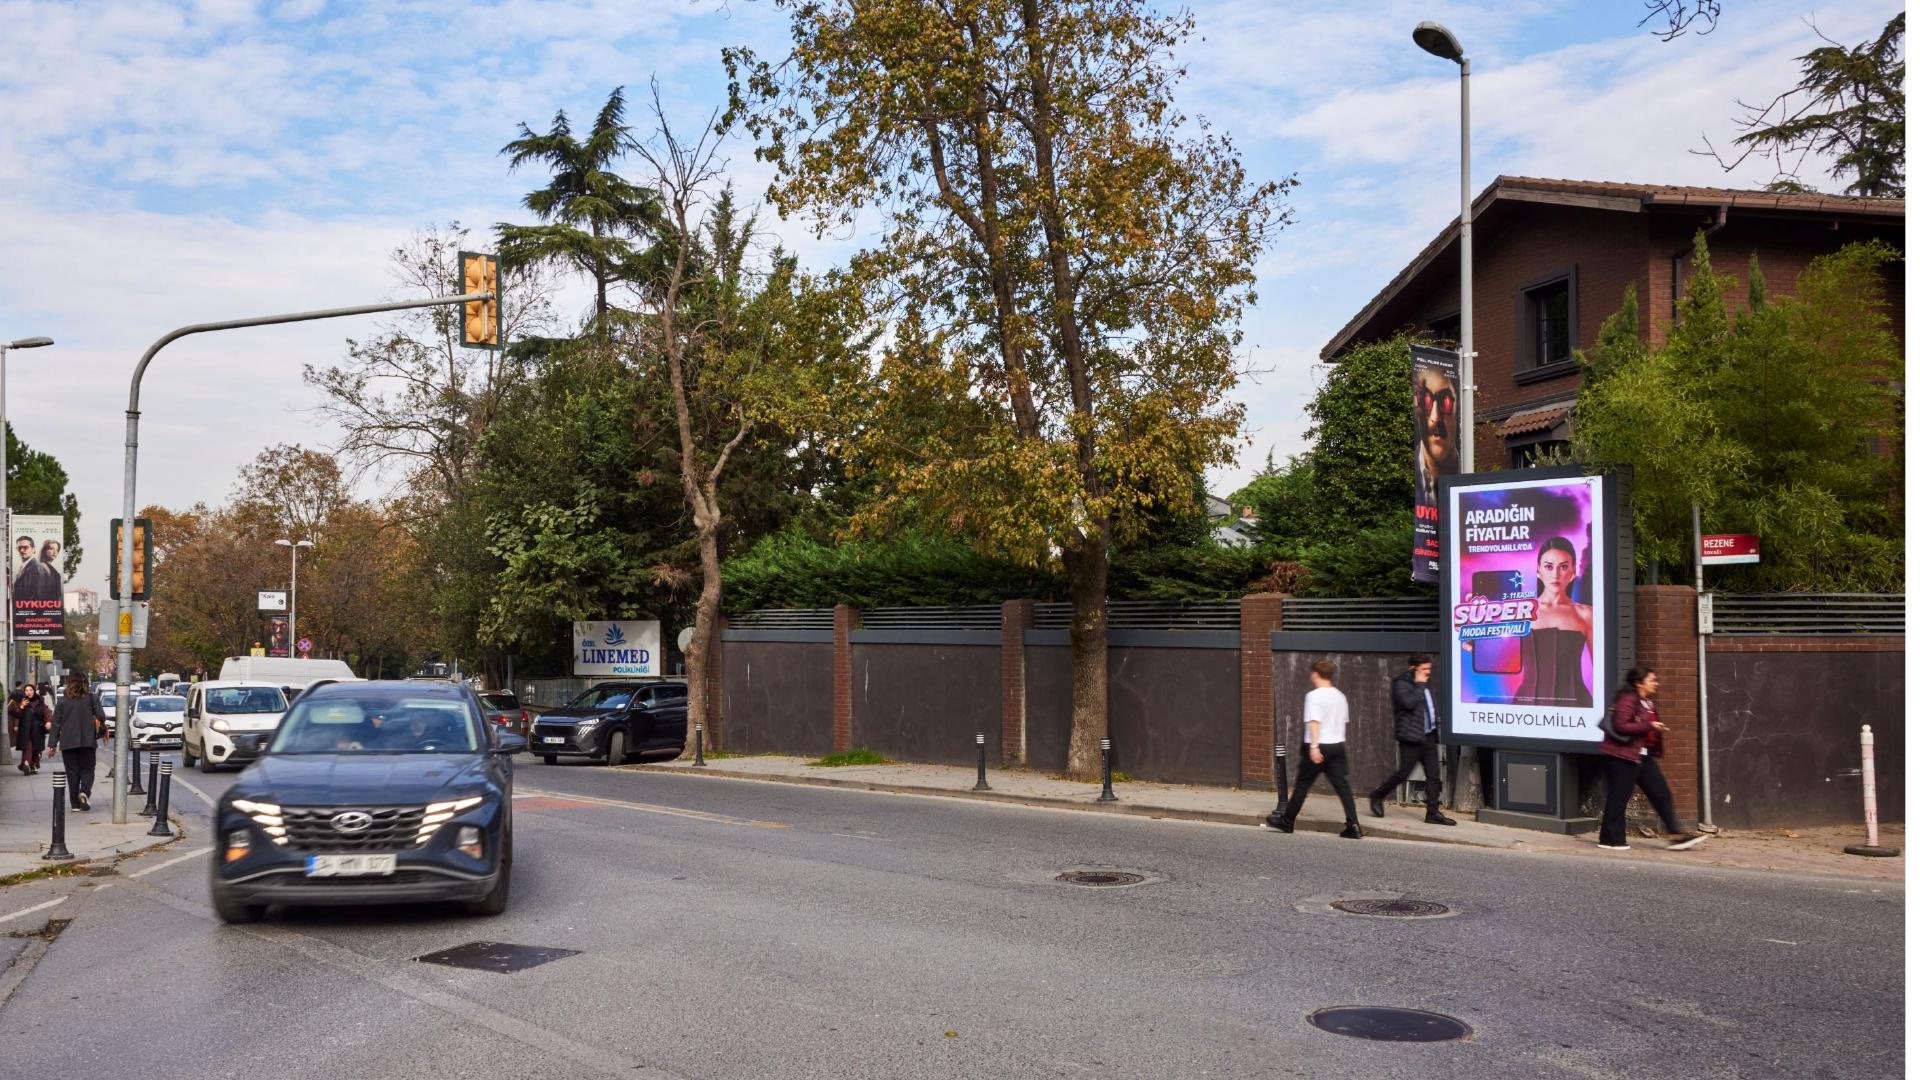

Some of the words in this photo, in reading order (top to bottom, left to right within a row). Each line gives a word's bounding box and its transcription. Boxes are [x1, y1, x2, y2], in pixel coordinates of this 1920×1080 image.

[1465, 503, 1535, 525] ARADIĞIN
[1466, 525, 1530, 542] FİYATLAR
[1704, 539, 1735, 548] REZENE
[15, 600, 62, 608] UYKUCU
[1454, 600, 1535, 624] SÜPER
[1462, 626, 1487, 637] MODA
[582, 649, 650, 663] LINEMED
[1470, 711, 1587, 728] TRENDYOLMİLLA
